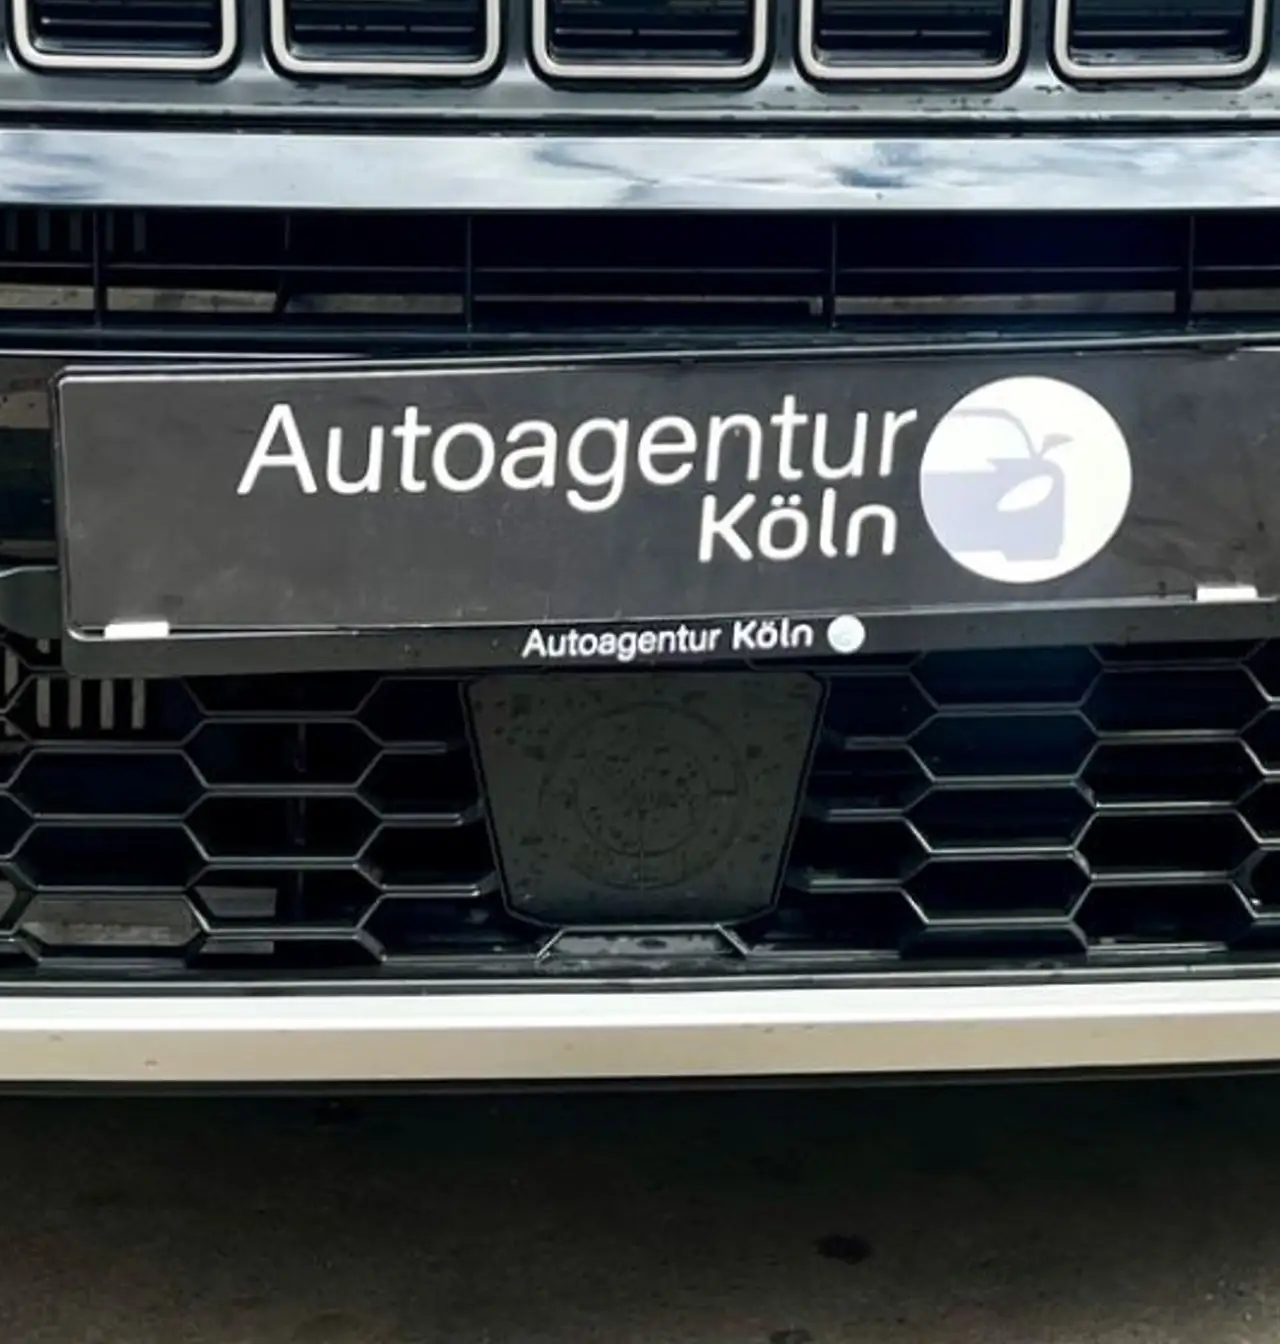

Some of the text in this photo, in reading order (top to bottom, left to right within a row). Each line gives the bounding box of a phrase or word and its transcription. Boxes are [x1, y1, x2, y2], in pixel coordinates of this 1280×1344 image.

[237, 395, 919, 513] Autoagentur
[696, 487, 898, 564] Köln
[521, 615, 815, 663] Autoagentur Köln
